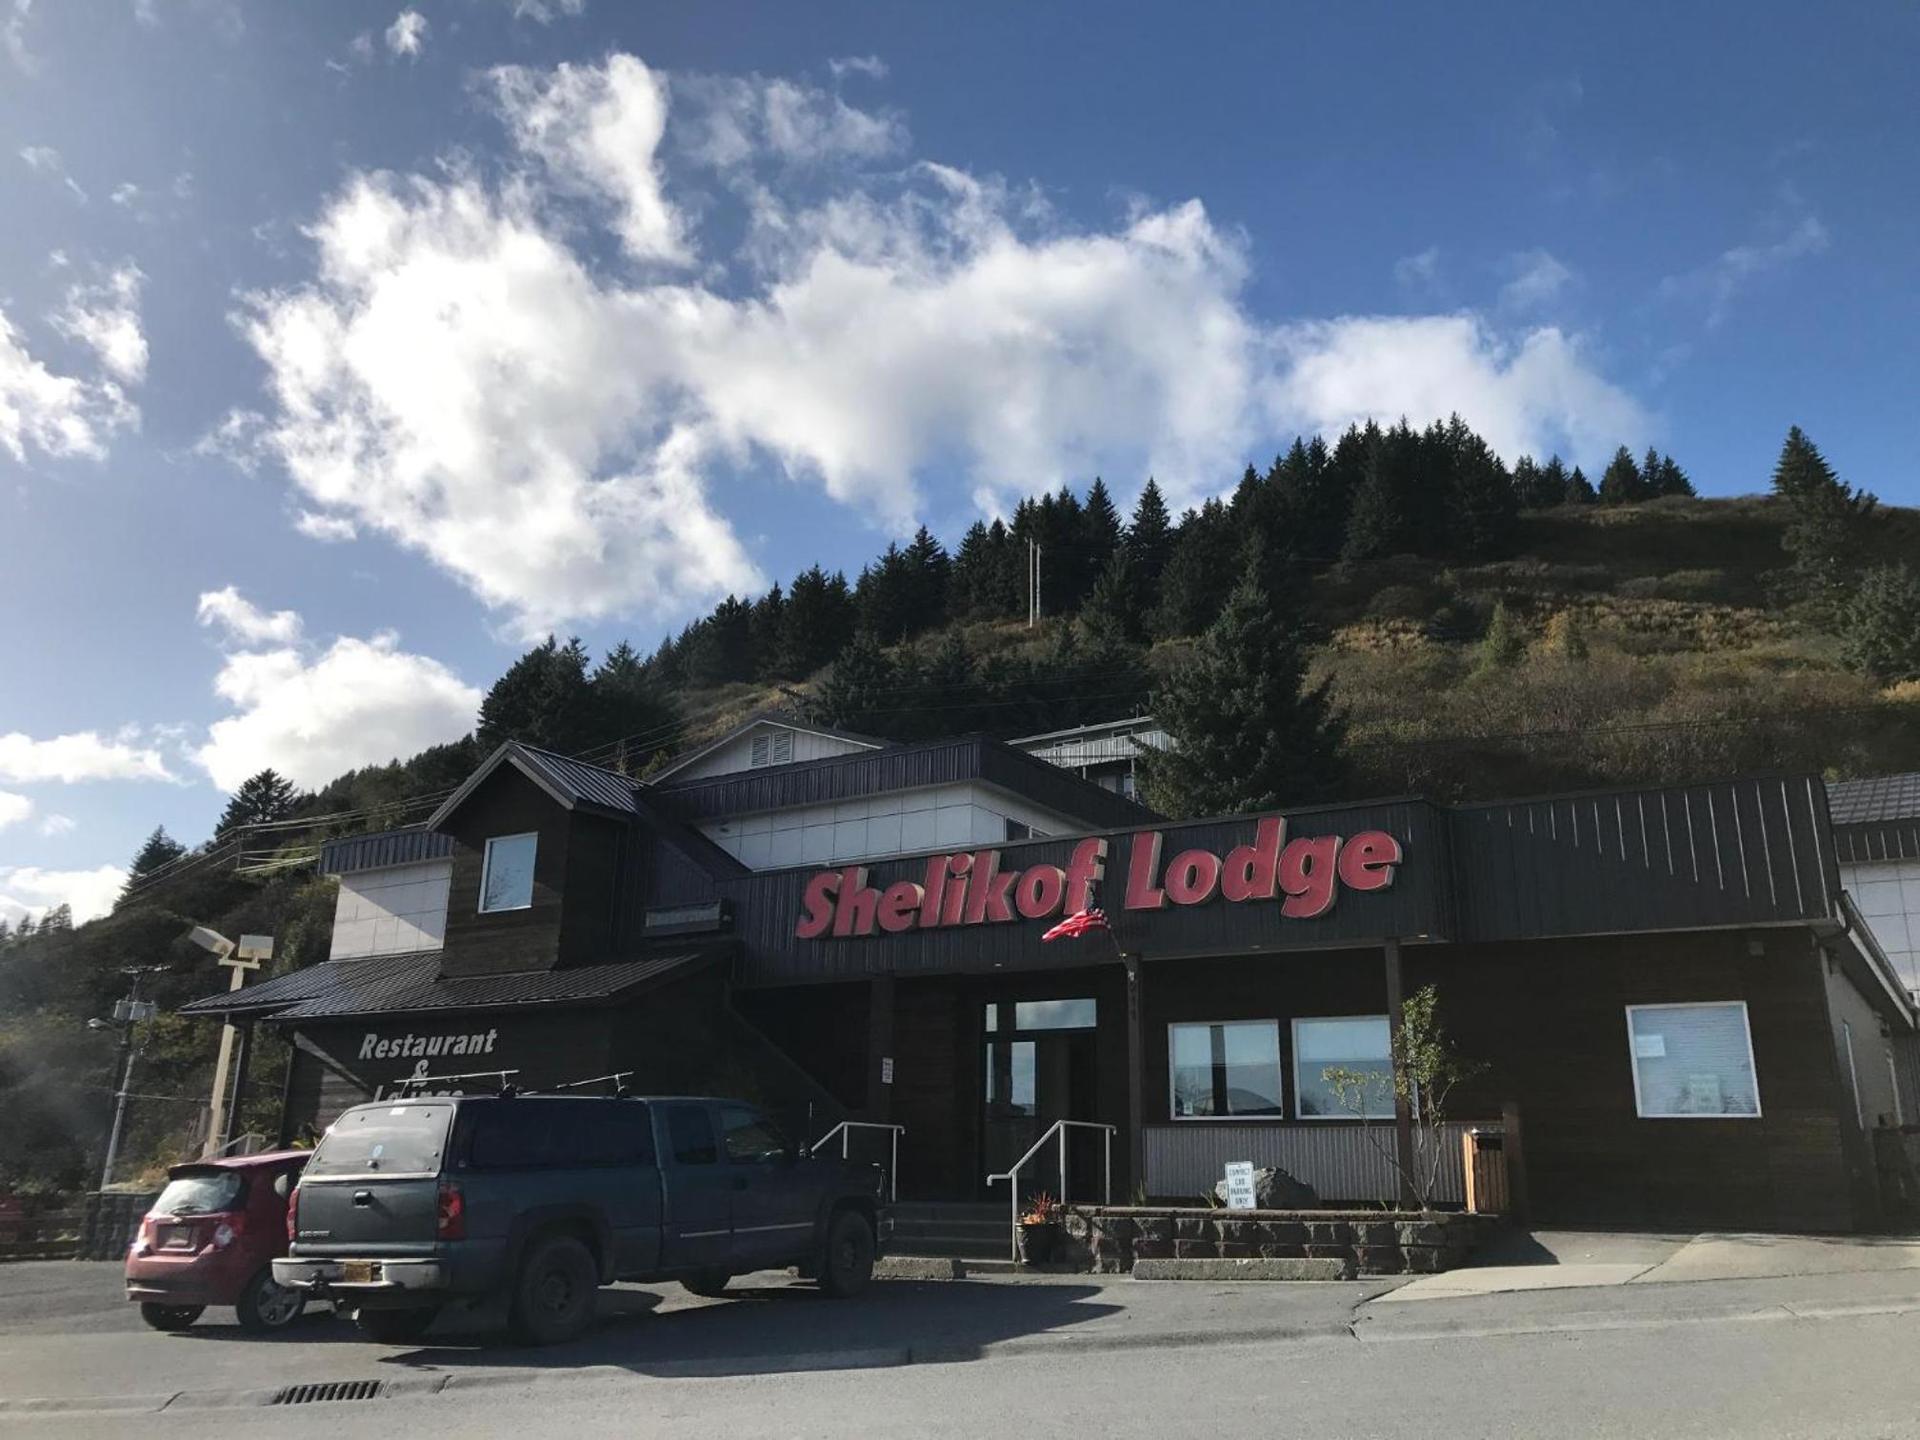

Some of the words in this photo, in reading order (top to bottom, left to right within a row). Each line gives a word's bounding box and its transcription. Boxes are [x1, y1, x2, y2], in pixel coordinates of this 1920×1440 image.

[796, 837, 1108, 939] Shelikof
[1124, 816, 1402, 918] Lodge
[358, 1028, 498, 1060] Restaurant
[411, 1059, 429, 1087] &
